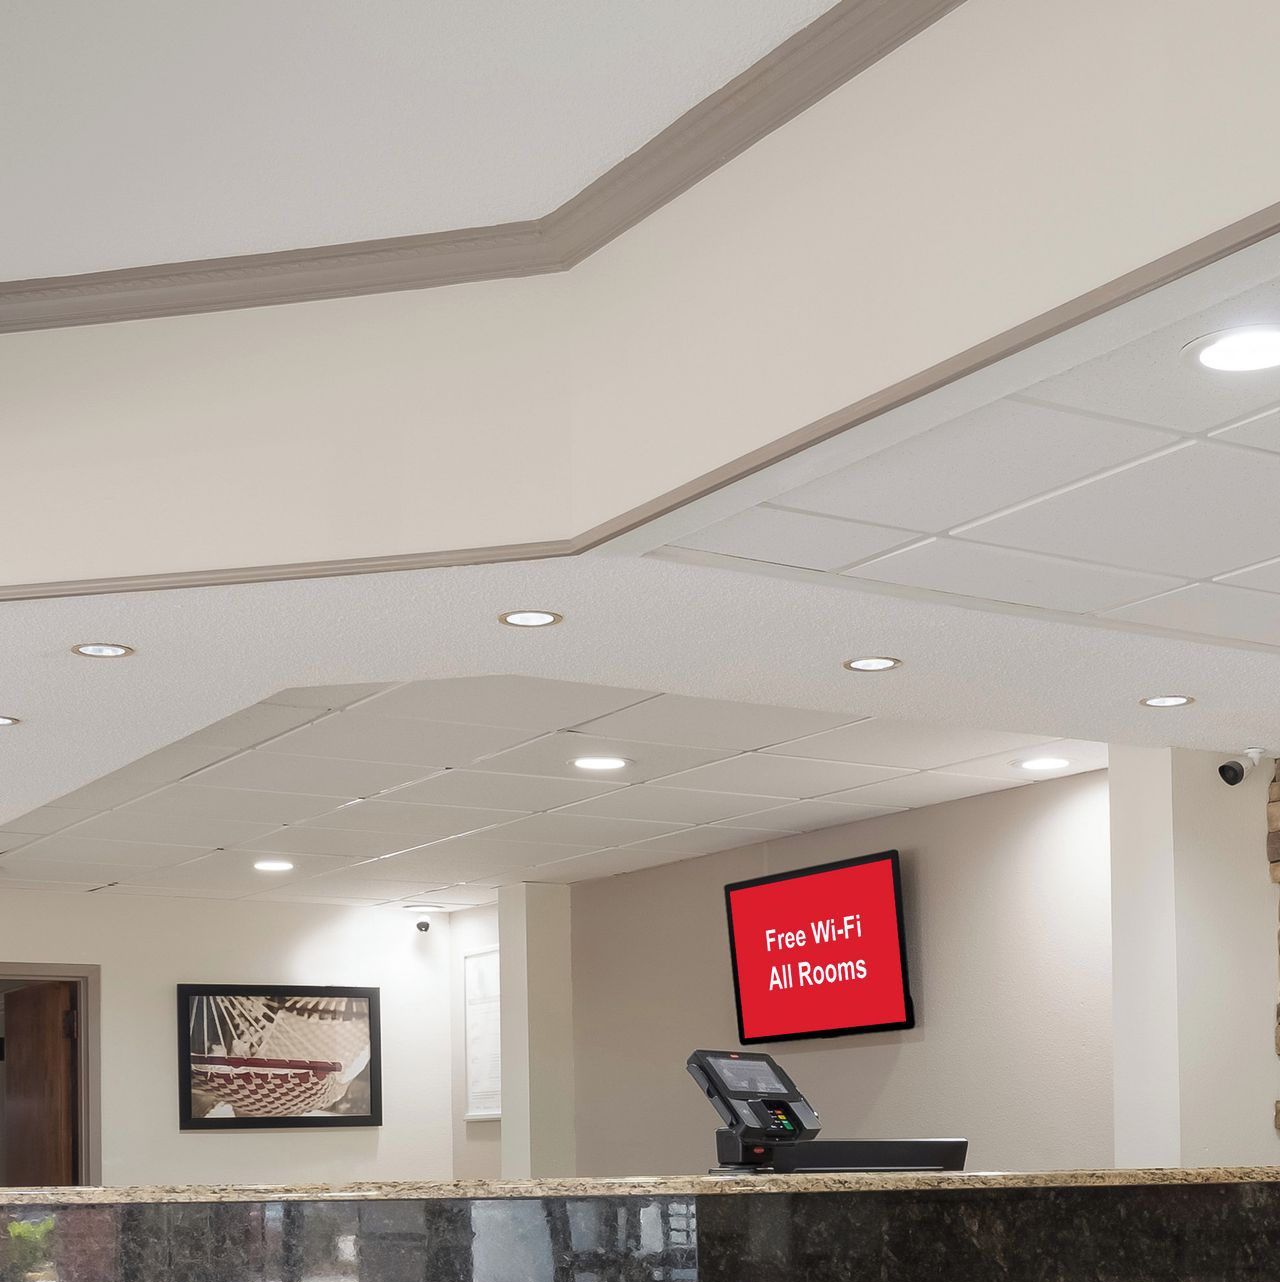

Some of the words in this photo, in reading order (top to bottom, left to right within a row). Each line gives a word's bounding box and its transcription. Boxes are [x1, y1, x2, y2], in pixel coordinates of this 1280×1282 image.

[765, 928, 807, 952] Free
[810, 914, 862, 944] Wi-Fi
[768, 963, 793, 991] All
[797, 959, 868, 987] Rooms
